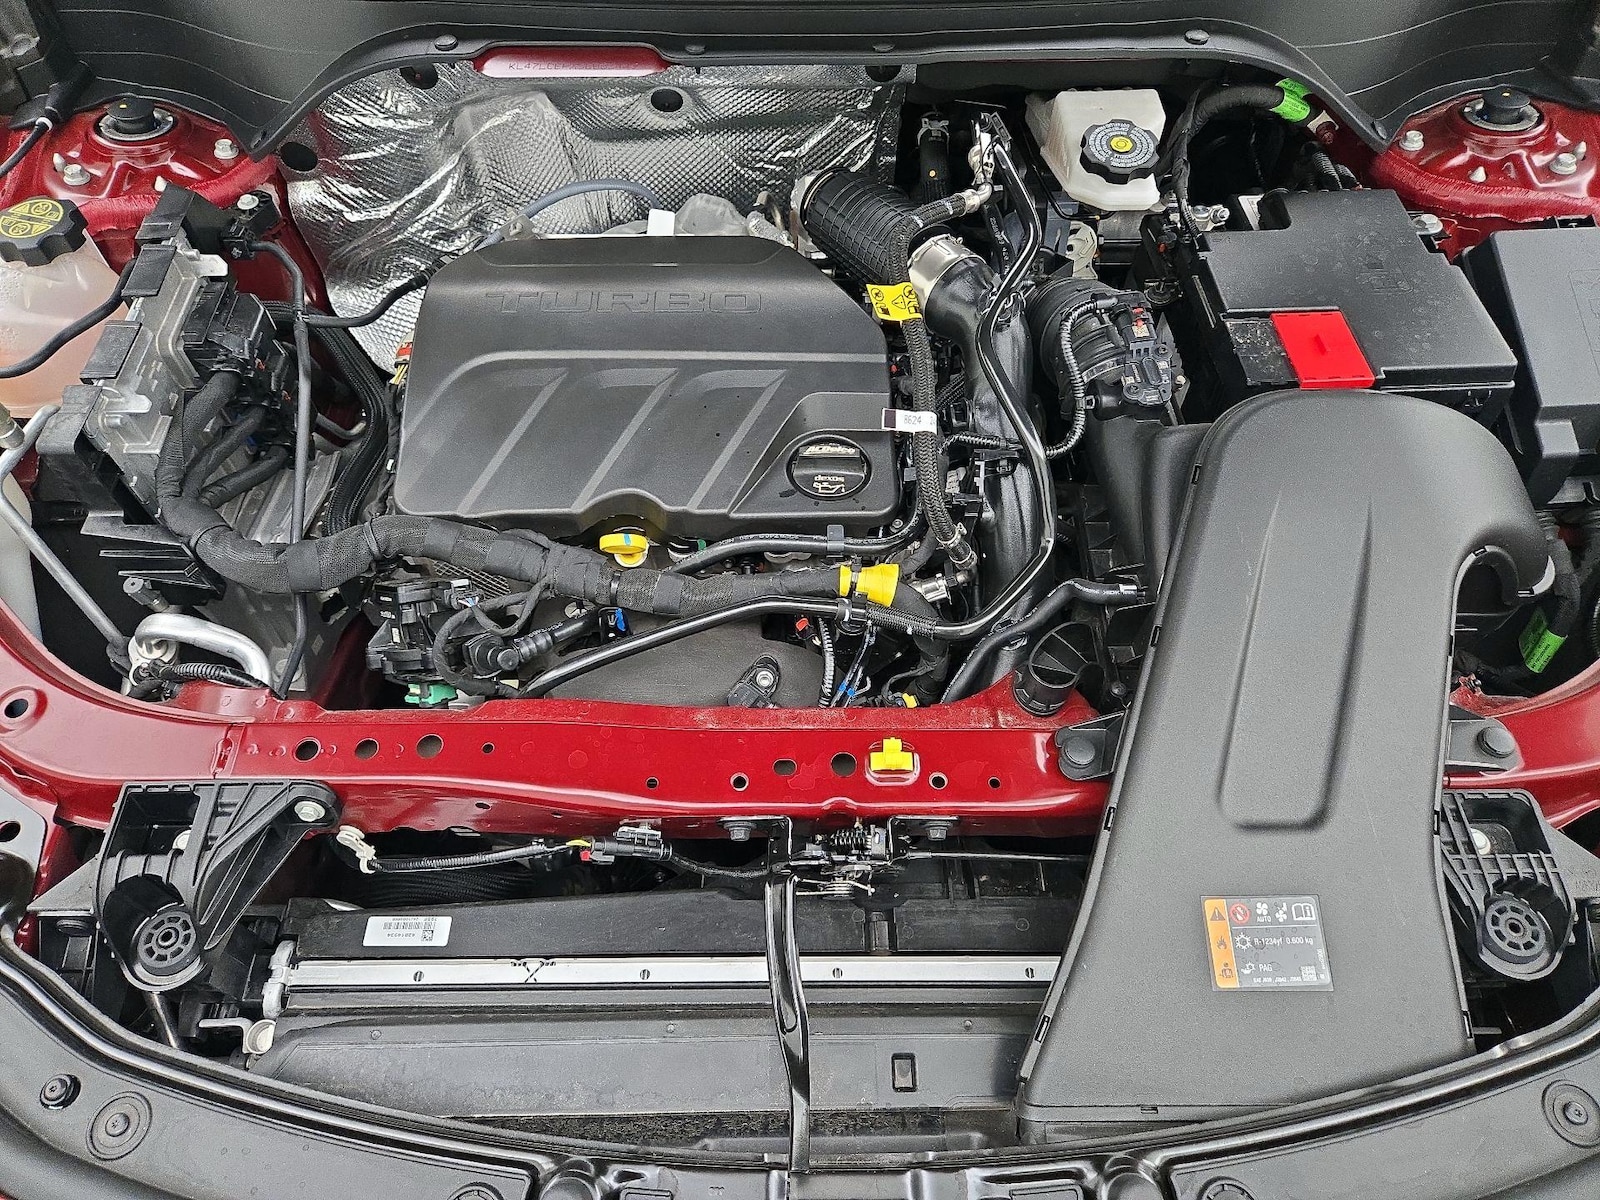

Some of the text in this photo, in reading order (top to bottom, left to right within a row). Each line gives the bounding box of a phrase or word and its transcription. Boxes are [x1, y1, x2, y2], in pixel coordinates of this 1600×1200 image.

[485, 291, 761, 313] TURBO
[803, 446, 856, 455] ACDelco
[1254, 937, 1283, 946] R-1234yf
[1304, 937, 1313, 945] kg
[1258, 964, 1273, 972] PAG
